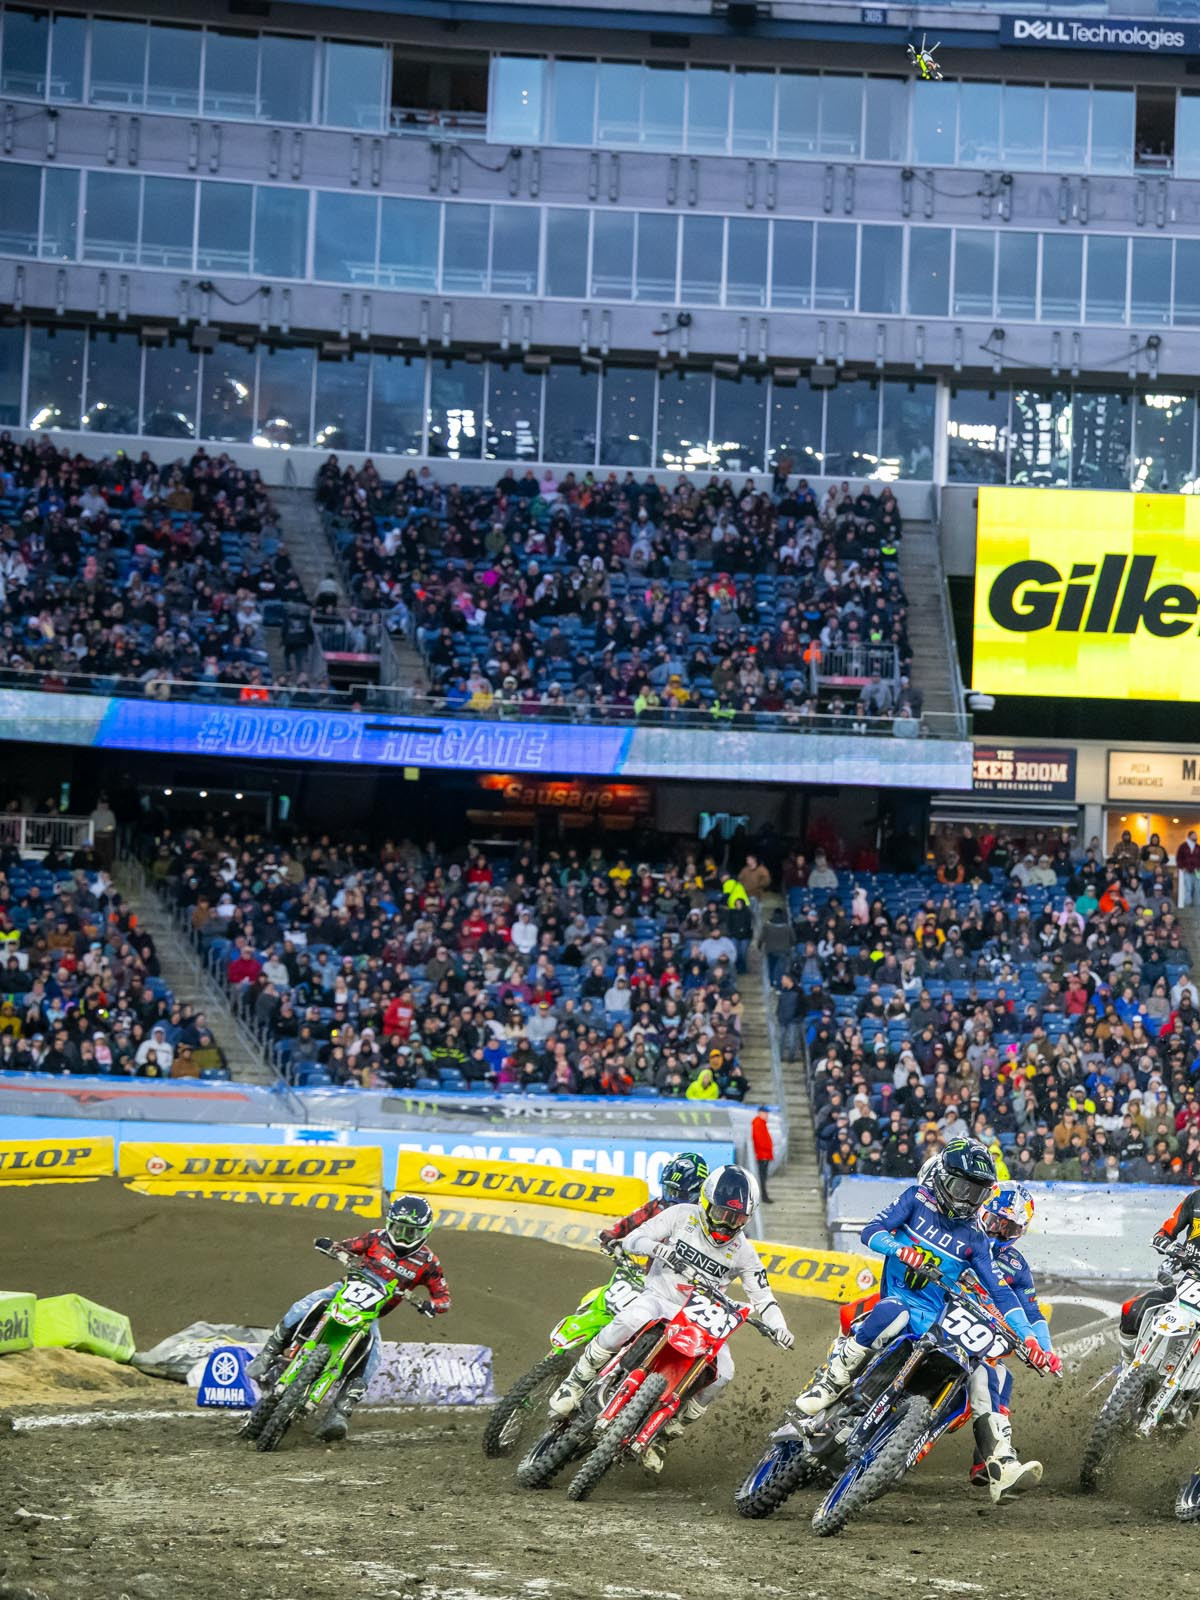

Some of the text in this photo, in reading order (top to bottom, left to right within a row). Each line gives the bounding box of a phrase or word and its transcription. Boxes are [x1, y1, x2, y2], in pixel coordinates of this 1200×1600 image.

[1013, 19, 1186, 50] DELL Technologies
[1015, 761, 1068, 783] ROOM
[503, 782, 613, 810] Sausage
[179, 1156, 357, 1177] DUNLOP
[450, 1169, 617, 1203] DUNLOP
[341, 1281, 385, 1310] 137
[204, 1386, 246, 1402] YAMAHA
